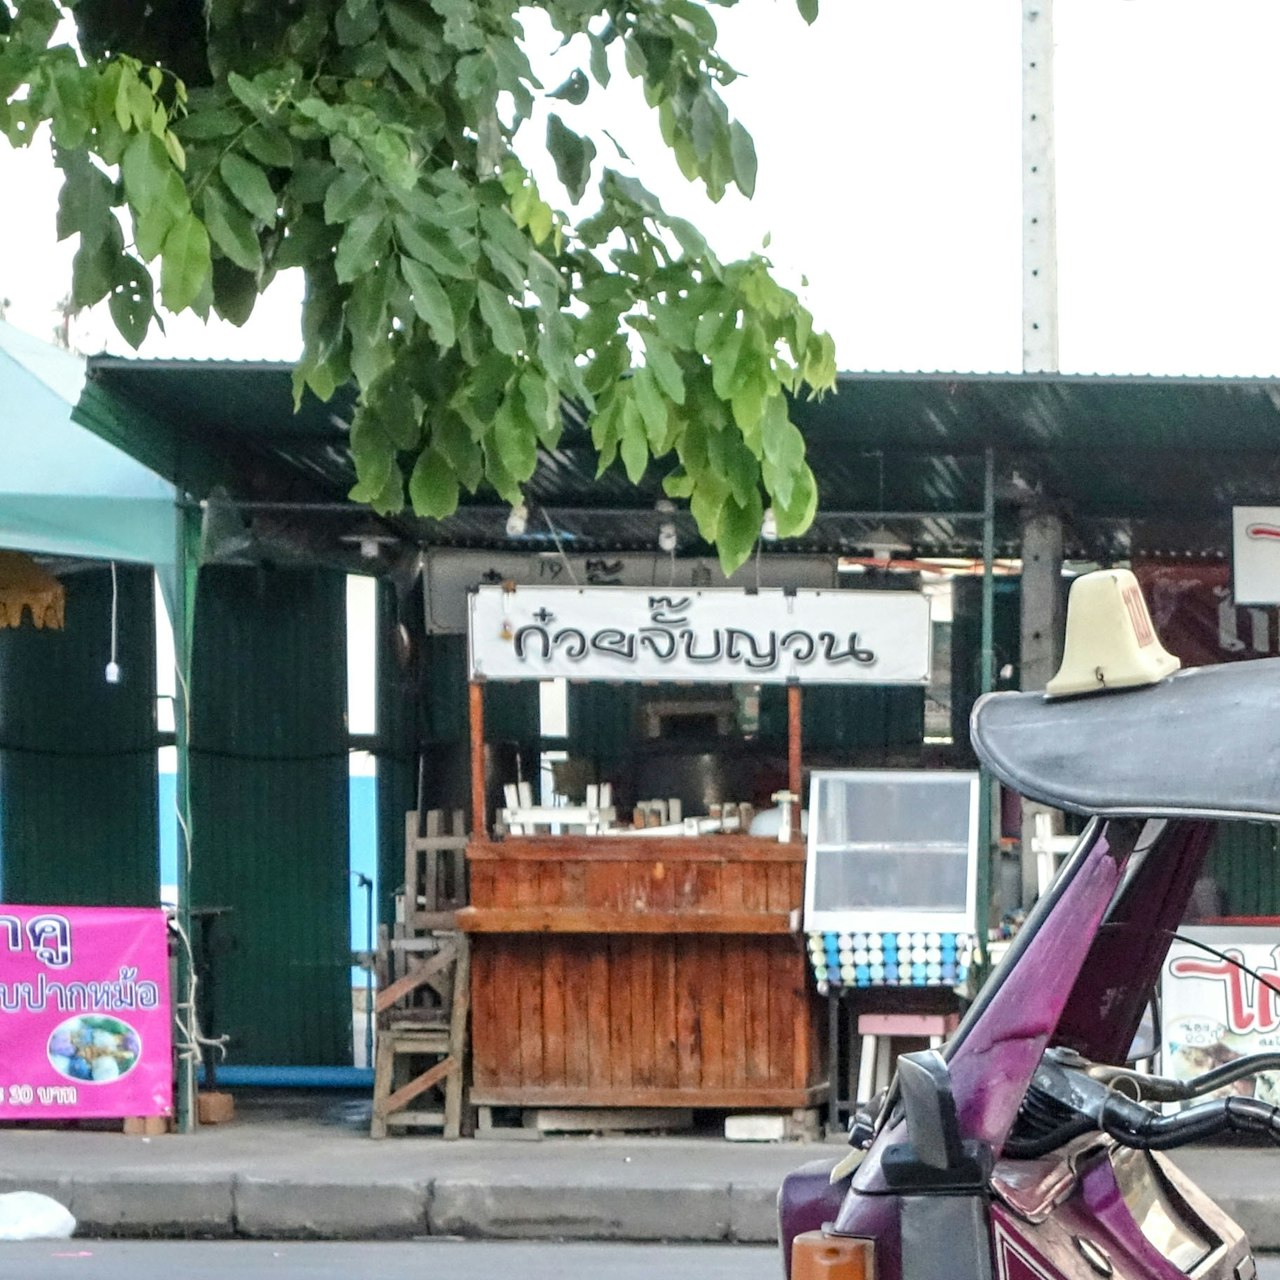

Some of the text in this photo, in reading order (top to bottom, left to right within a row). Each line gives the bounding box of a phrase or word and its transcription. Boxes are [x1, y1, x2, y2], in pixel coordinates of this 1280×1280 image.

[513, 595, 877, 669] ก๋วยจั๊บญวน
